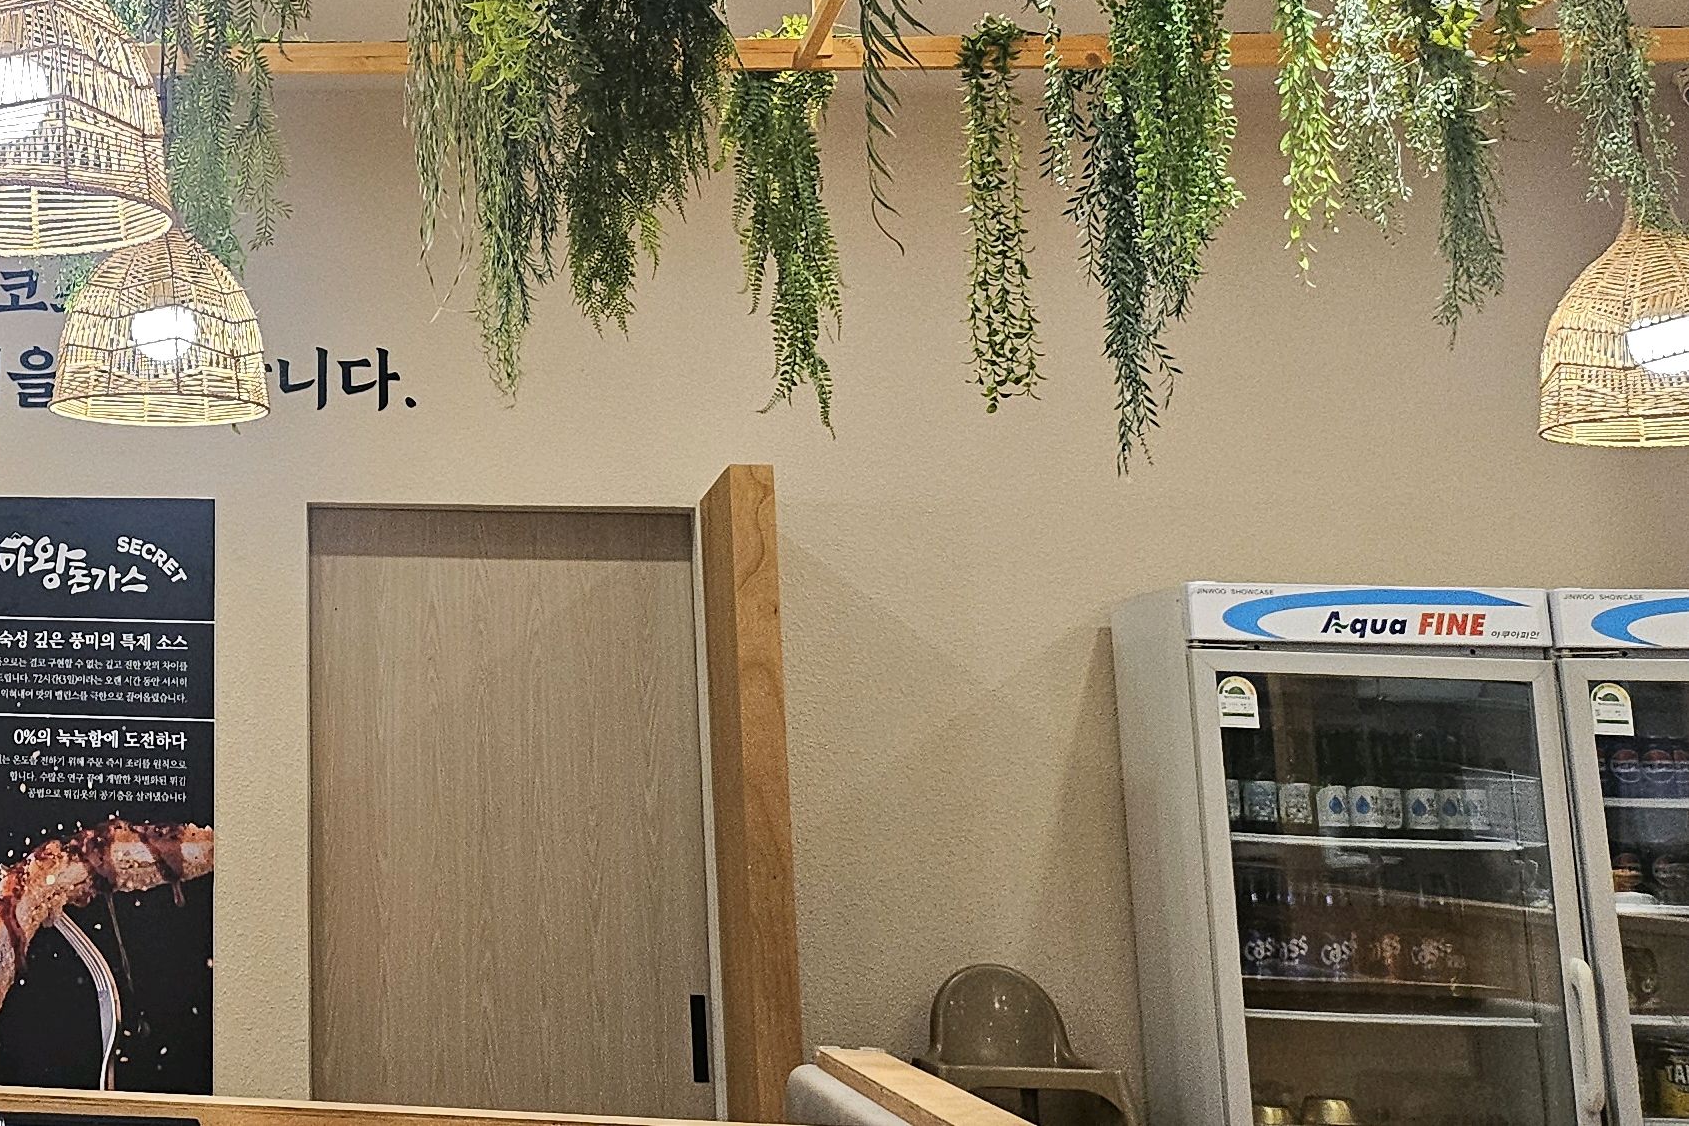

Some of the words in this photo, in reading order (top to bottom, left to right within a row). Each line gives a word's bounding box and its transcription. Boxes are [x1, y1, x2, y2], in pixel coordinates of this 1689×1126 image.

[116, 536, 188, 584] SECRET
[1230, 588, 1274, 596] SHOWCASE
[1599, 593, 1644, 601] SHOWCASE
[1320, 611, 1407, 639] Aqua
[1417, 612, 1487, 637] FINE
[33, 631, 66, 648] 깊은
[68, 632, 115, 650] 풍미의
[119, 633, 151, 651] 특제
[155, 635, 189, 649] 소스
[13, 728, 51, 746] 0%의
[55, 729, 119, 748] 눅눅함에
[122, 731, 189, 750] 도전하다
